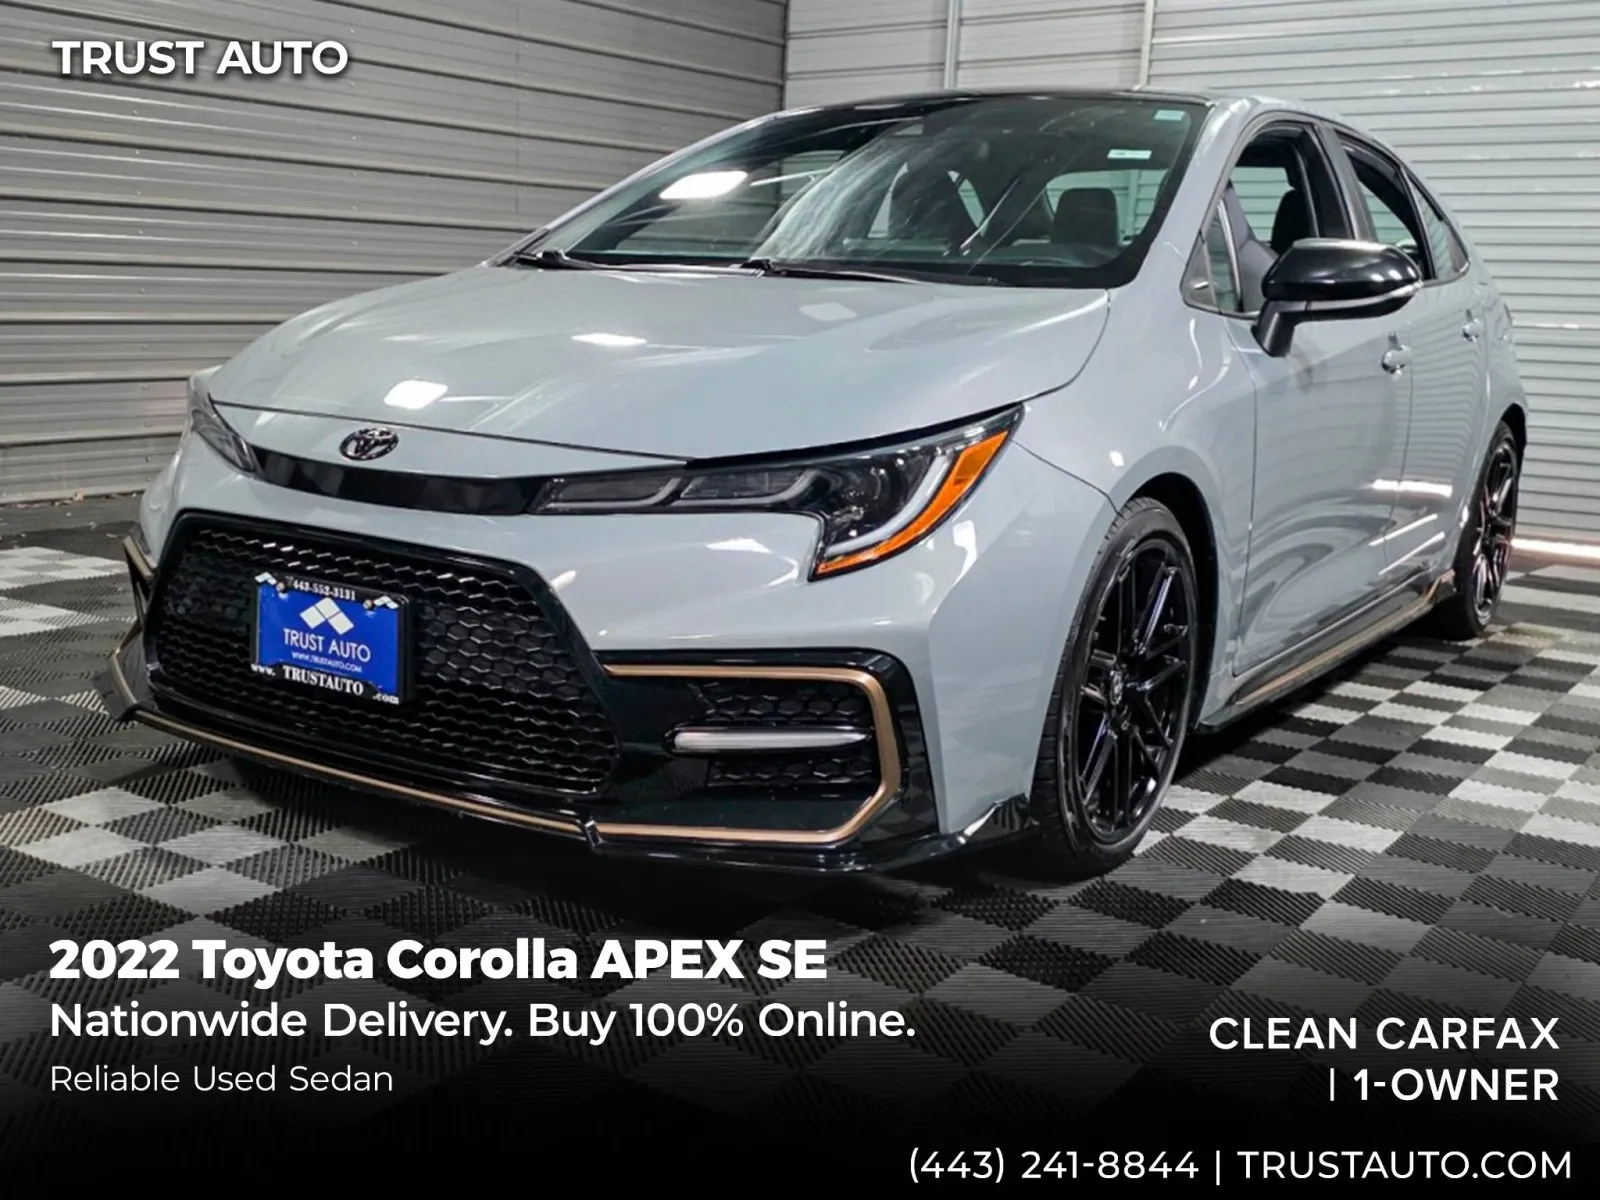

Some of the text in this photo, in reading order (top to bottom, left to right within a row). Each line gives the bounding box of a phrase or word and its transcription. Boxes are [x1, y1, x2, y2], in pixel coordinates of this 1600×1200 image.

[283, 628, 371, 663] TRUST AUTO
[282, 665, 364, 695] TRUSTAUTO
